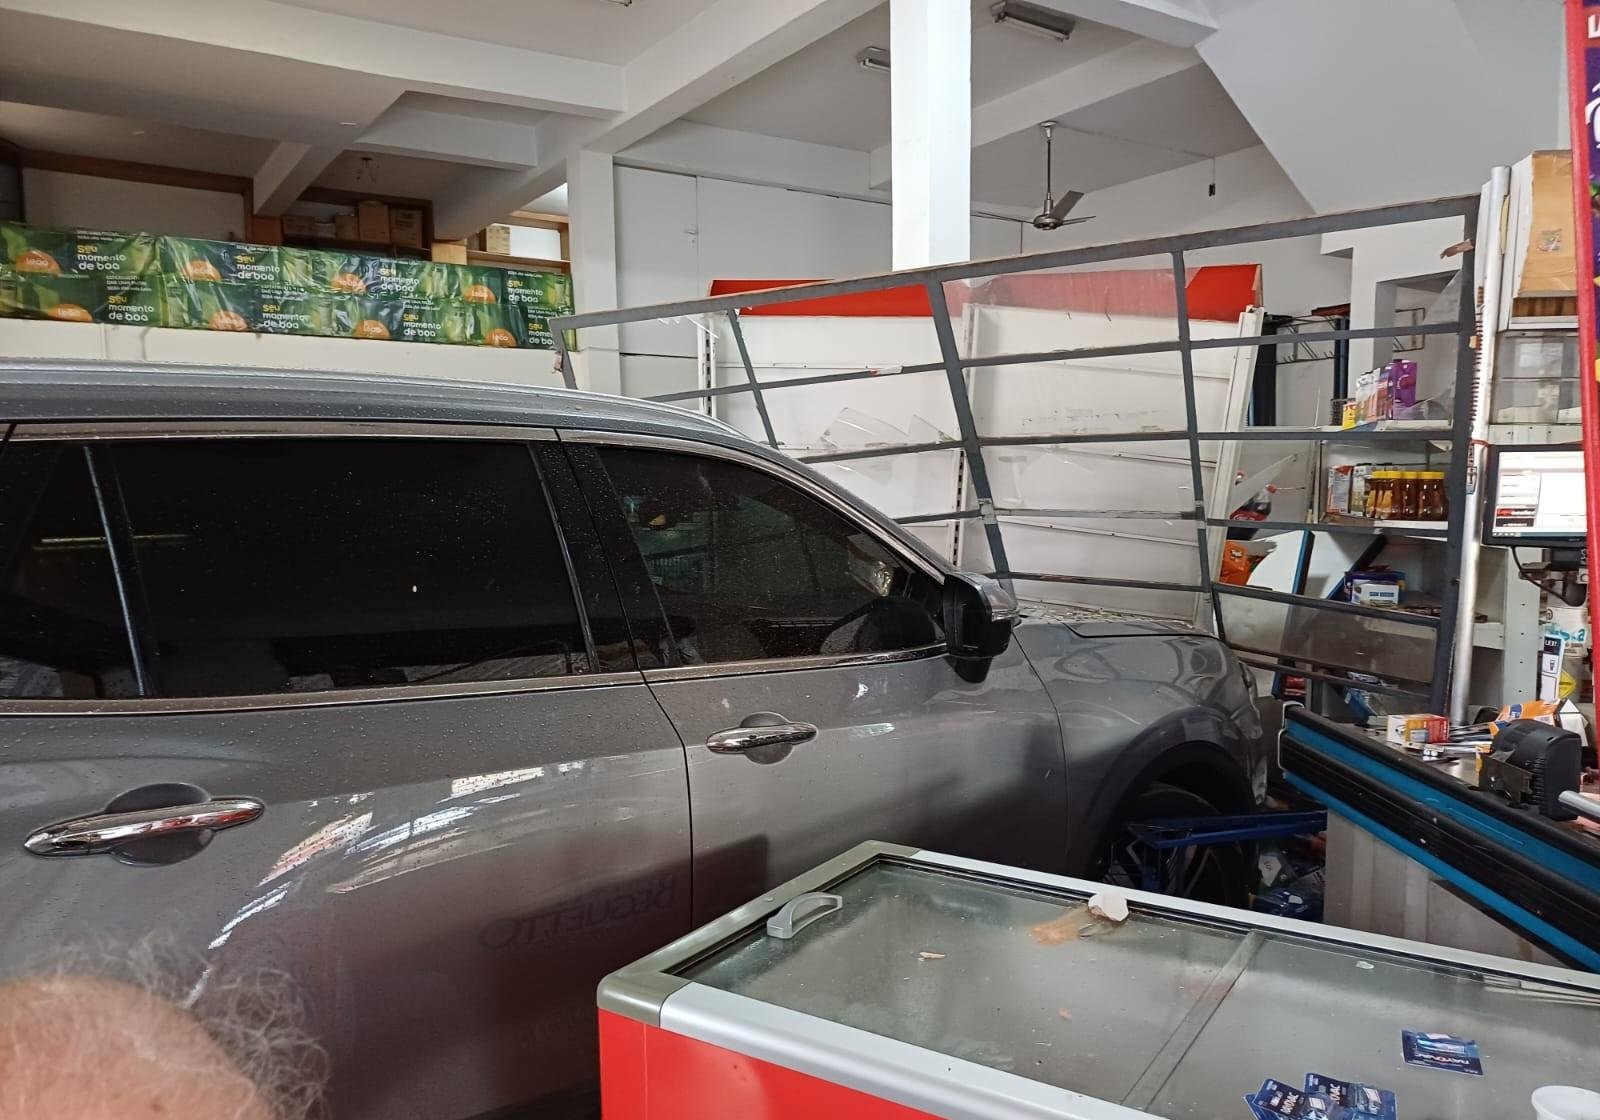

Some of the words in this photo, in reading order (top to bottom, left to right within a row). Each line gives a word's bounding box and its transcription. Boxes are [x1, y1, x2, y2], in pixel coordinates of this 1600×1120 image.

[76, 245, 98, 254] seu
[77, 254, 127, 262] momento
[234, 255, 255, 263] seu
[78, 261, 94, 270] de
[96, 262, 120, 270] boa
[236, 264, 280, 272] momento
[237, 271, 252, 279] de
[253, 272, 274, 280] boa
[395, 284, 414, 292] boa
[508, 288, 543, 296] momento
[108, 295, 127, 304] seu
[521, 295, 538, 303] boa
[108, 304, 154, 312] momento
[262, 304, 280, 312] seu
[108, 311, 123, 320] de
[124, 312, 149, 321] boa
[262, 313, 304, 321] momento
[278, 320, 299, 329] boa
[403, 322, 441, 330] momento
[403, 328, 416, 336] de
[417, 329, 436, 337] boa
[541, 337, 553, 345] bo
